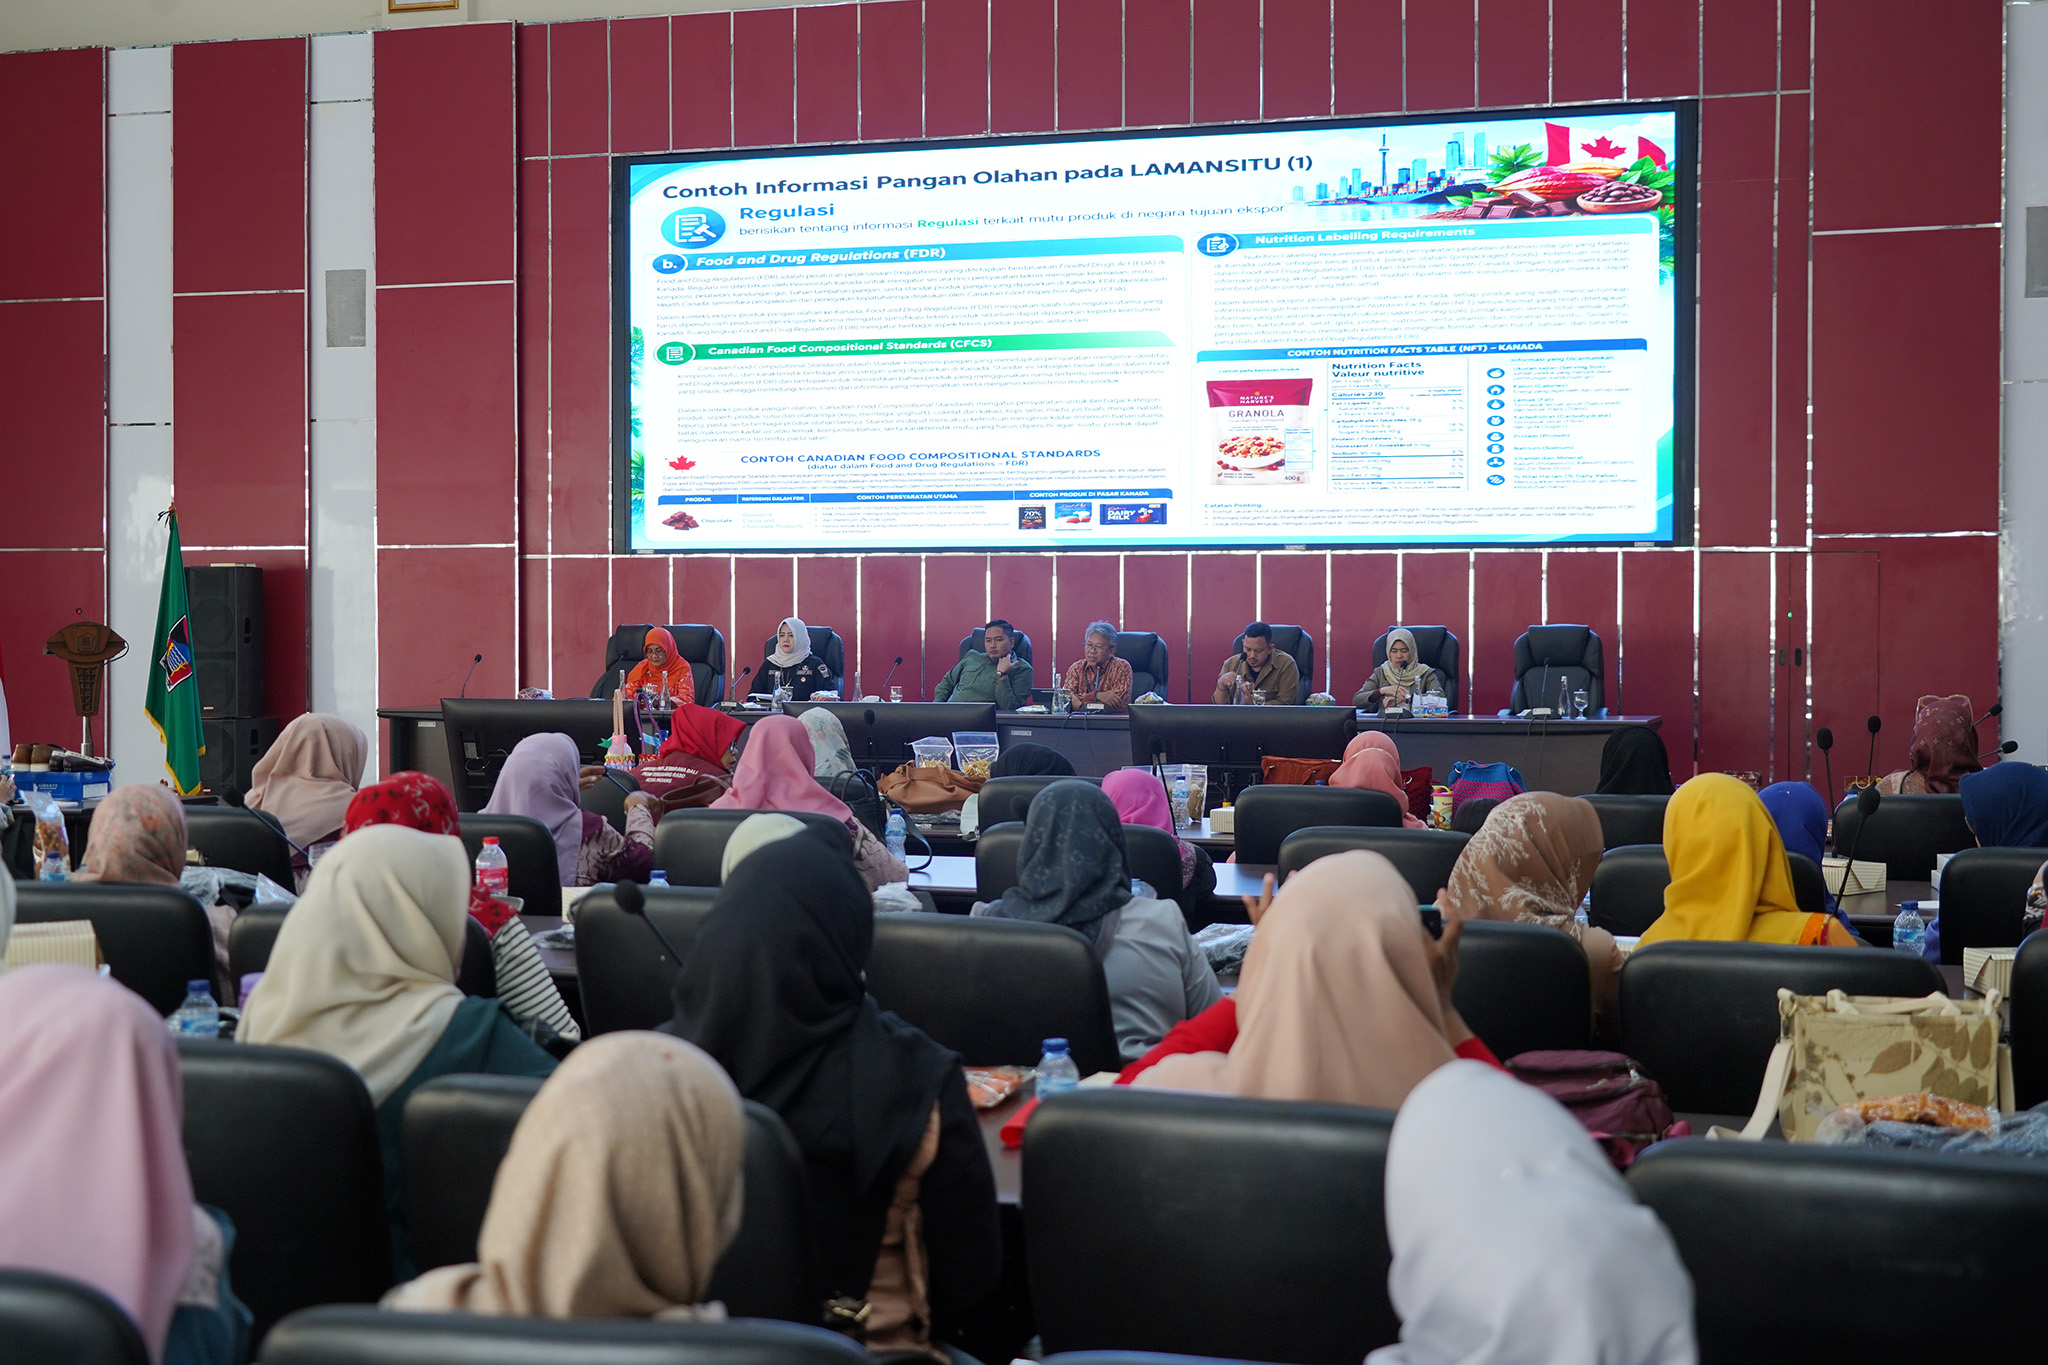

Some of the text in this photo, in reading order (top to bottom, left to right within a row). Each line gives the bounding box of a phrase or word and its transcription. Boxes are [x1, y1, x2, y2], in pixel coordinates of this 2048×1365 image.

[662, 155, 1312, 199] Contoh Informasi Pangan Olahan pada LAMANSITU (1)
[739, 202, 1291, 236] berisikan tentang informasi Regulasi terkait mutu produk di negara tujuan ekspor.
[740, 203, 833, 221] Regulasi
[1255, 227, 1475, 244] Nutrition Labelling Requirements
[696, 256, 733, 266] Food
[736, 255, 766, 265] and
[768, 253, 806, 266] Drug
[810, 249, 899, 264] Regulations
[903, 247, 945, 260] (FDR)
[708, 338, 992, 355] Canadian Food Compositional Standards (CFCS)
[1286, 343, 1543, 357] CONTOH NUTRITION FACTS TABLE (NFT) KANADA
[1389, 360, 1421, 368] Facts
[1332, 370, 1370, 378] Valeur
[1228, 409, 1284, 418] GRANOLA
[740, 449, 1100, 463] CONTOH CANADIAN FOOD COMPOSITIONAL STANDARDS
[915, 461, 937, 469] Drug
[940, 460, 995, 468] Regulations
